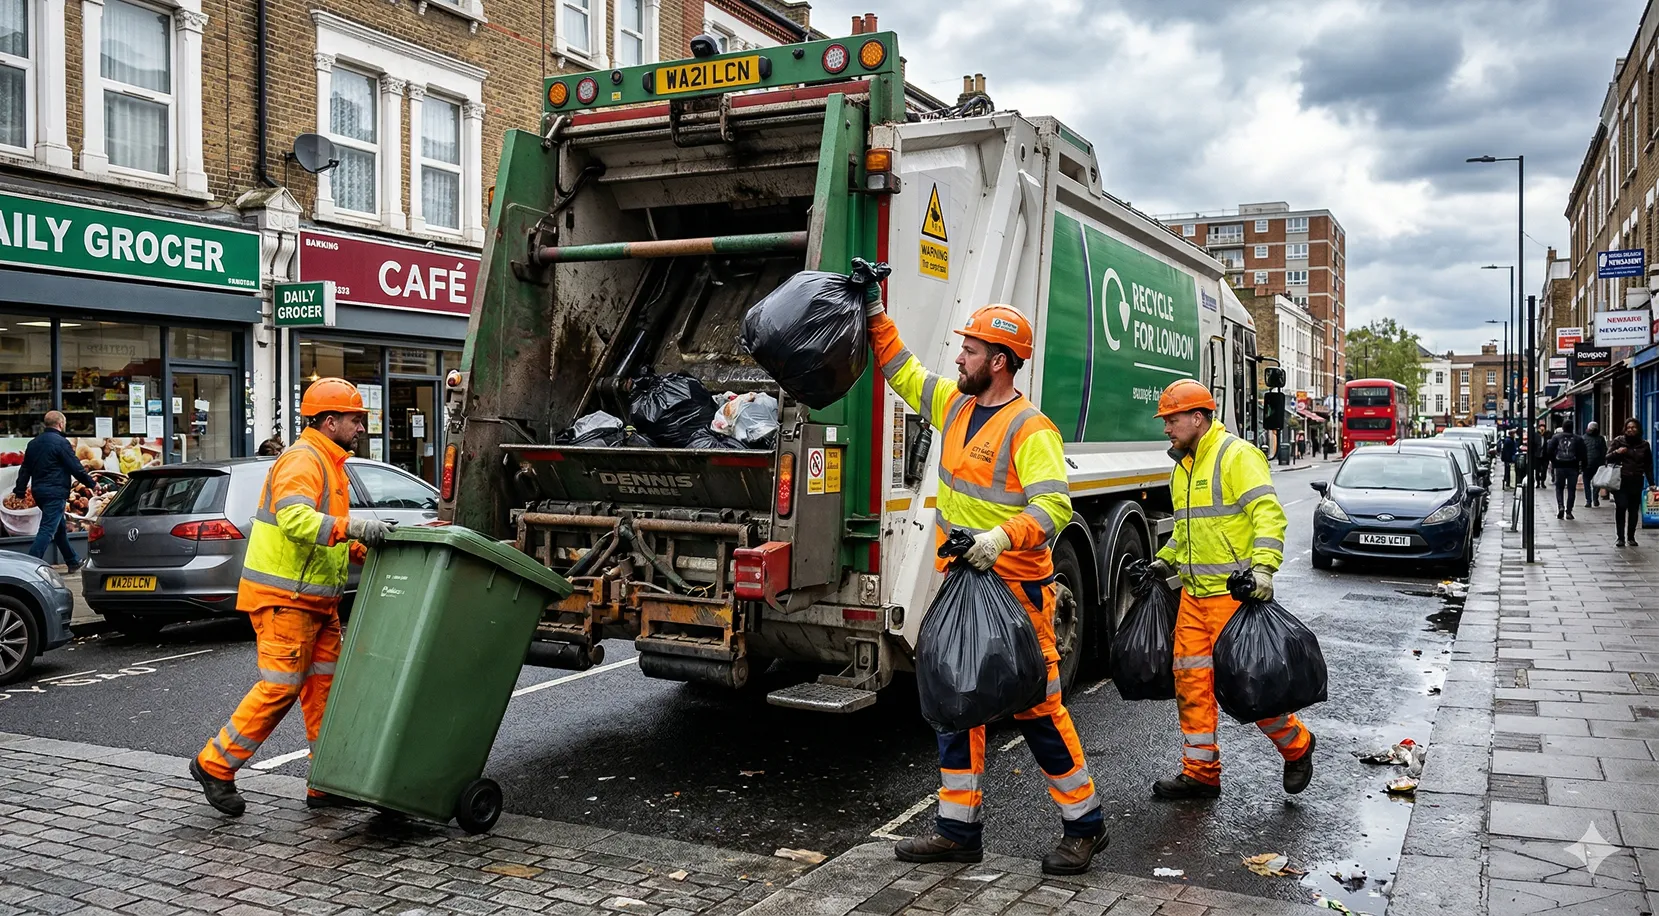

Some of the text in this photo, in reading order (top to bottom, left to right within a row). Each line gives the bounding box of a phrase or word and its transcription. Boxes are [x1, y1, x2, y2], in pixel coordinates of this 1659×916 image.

[666, 60, 750, 90] WA21 LCN
[84, 223, 225, 273] GROCER
[284, 289, 315, 304] DAILY
[378, 260, 468, 305] CAFÉ
[277, 305, 323, 319] GROCER
[1131, 281, 1174, 322] RECYCLE
[1134, 319, 1194, 361] FOR LONDON
[599, 472, 694, 488] DENNIS
[132, 577, 151, 589] LCN
